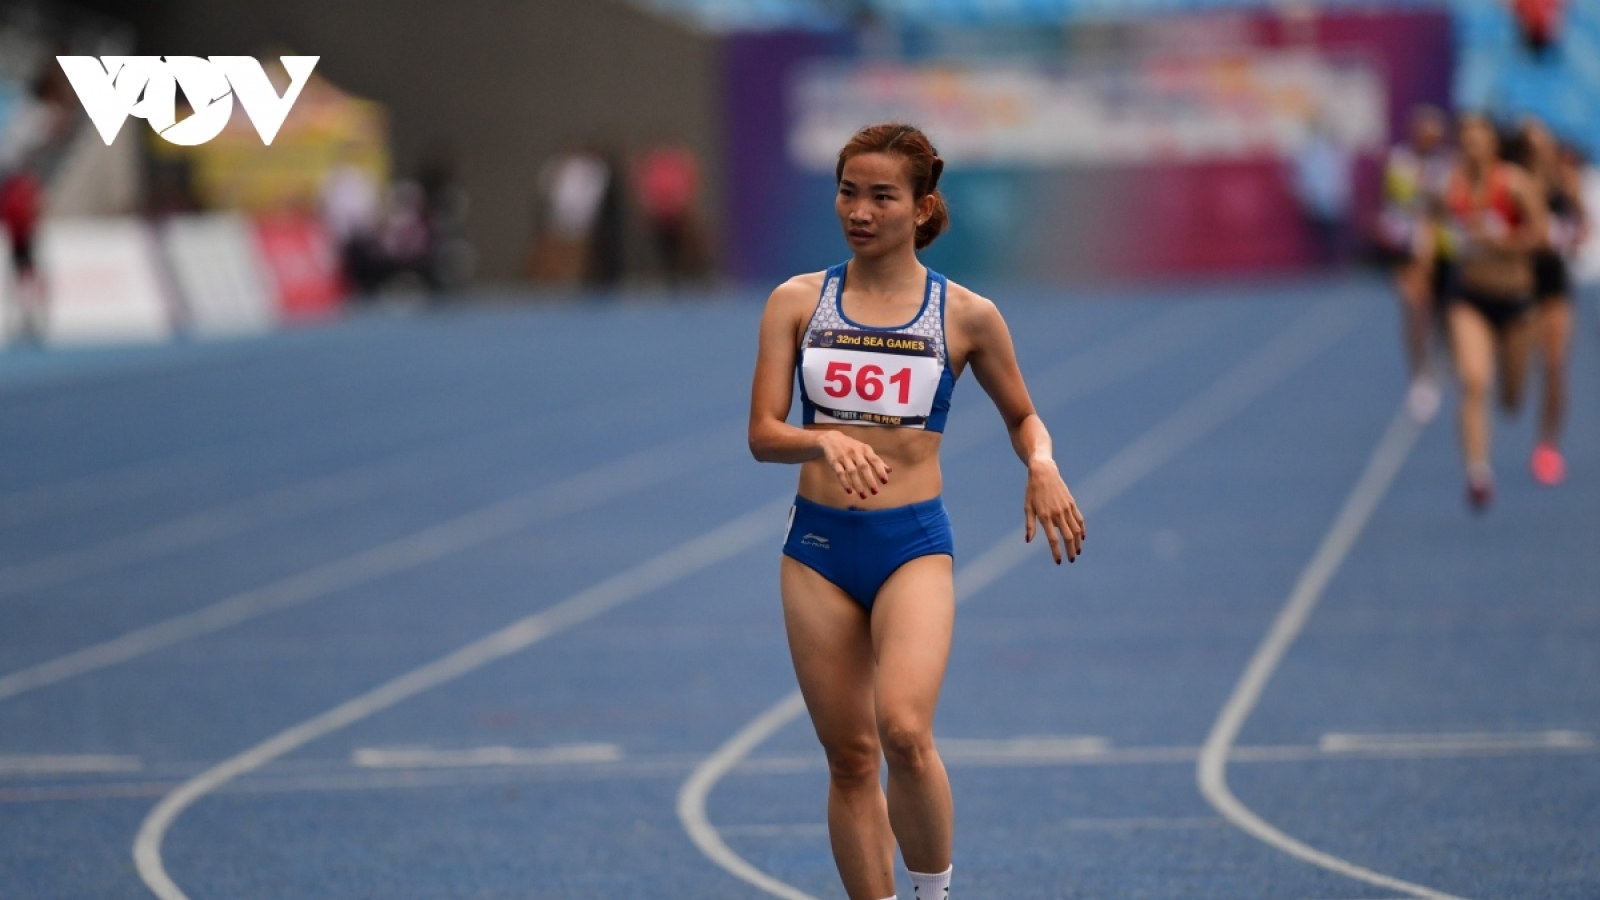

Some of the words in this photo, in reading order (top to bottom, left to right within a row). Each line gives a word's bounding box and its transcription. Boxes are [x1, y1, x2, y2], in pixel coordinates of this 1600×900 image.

[836, 335, 860, 345] 32nd
[863, 336, 884, 347] SEA
[886, 338, 924, 351] GAMES
[823, 361, 912, 405] 561
